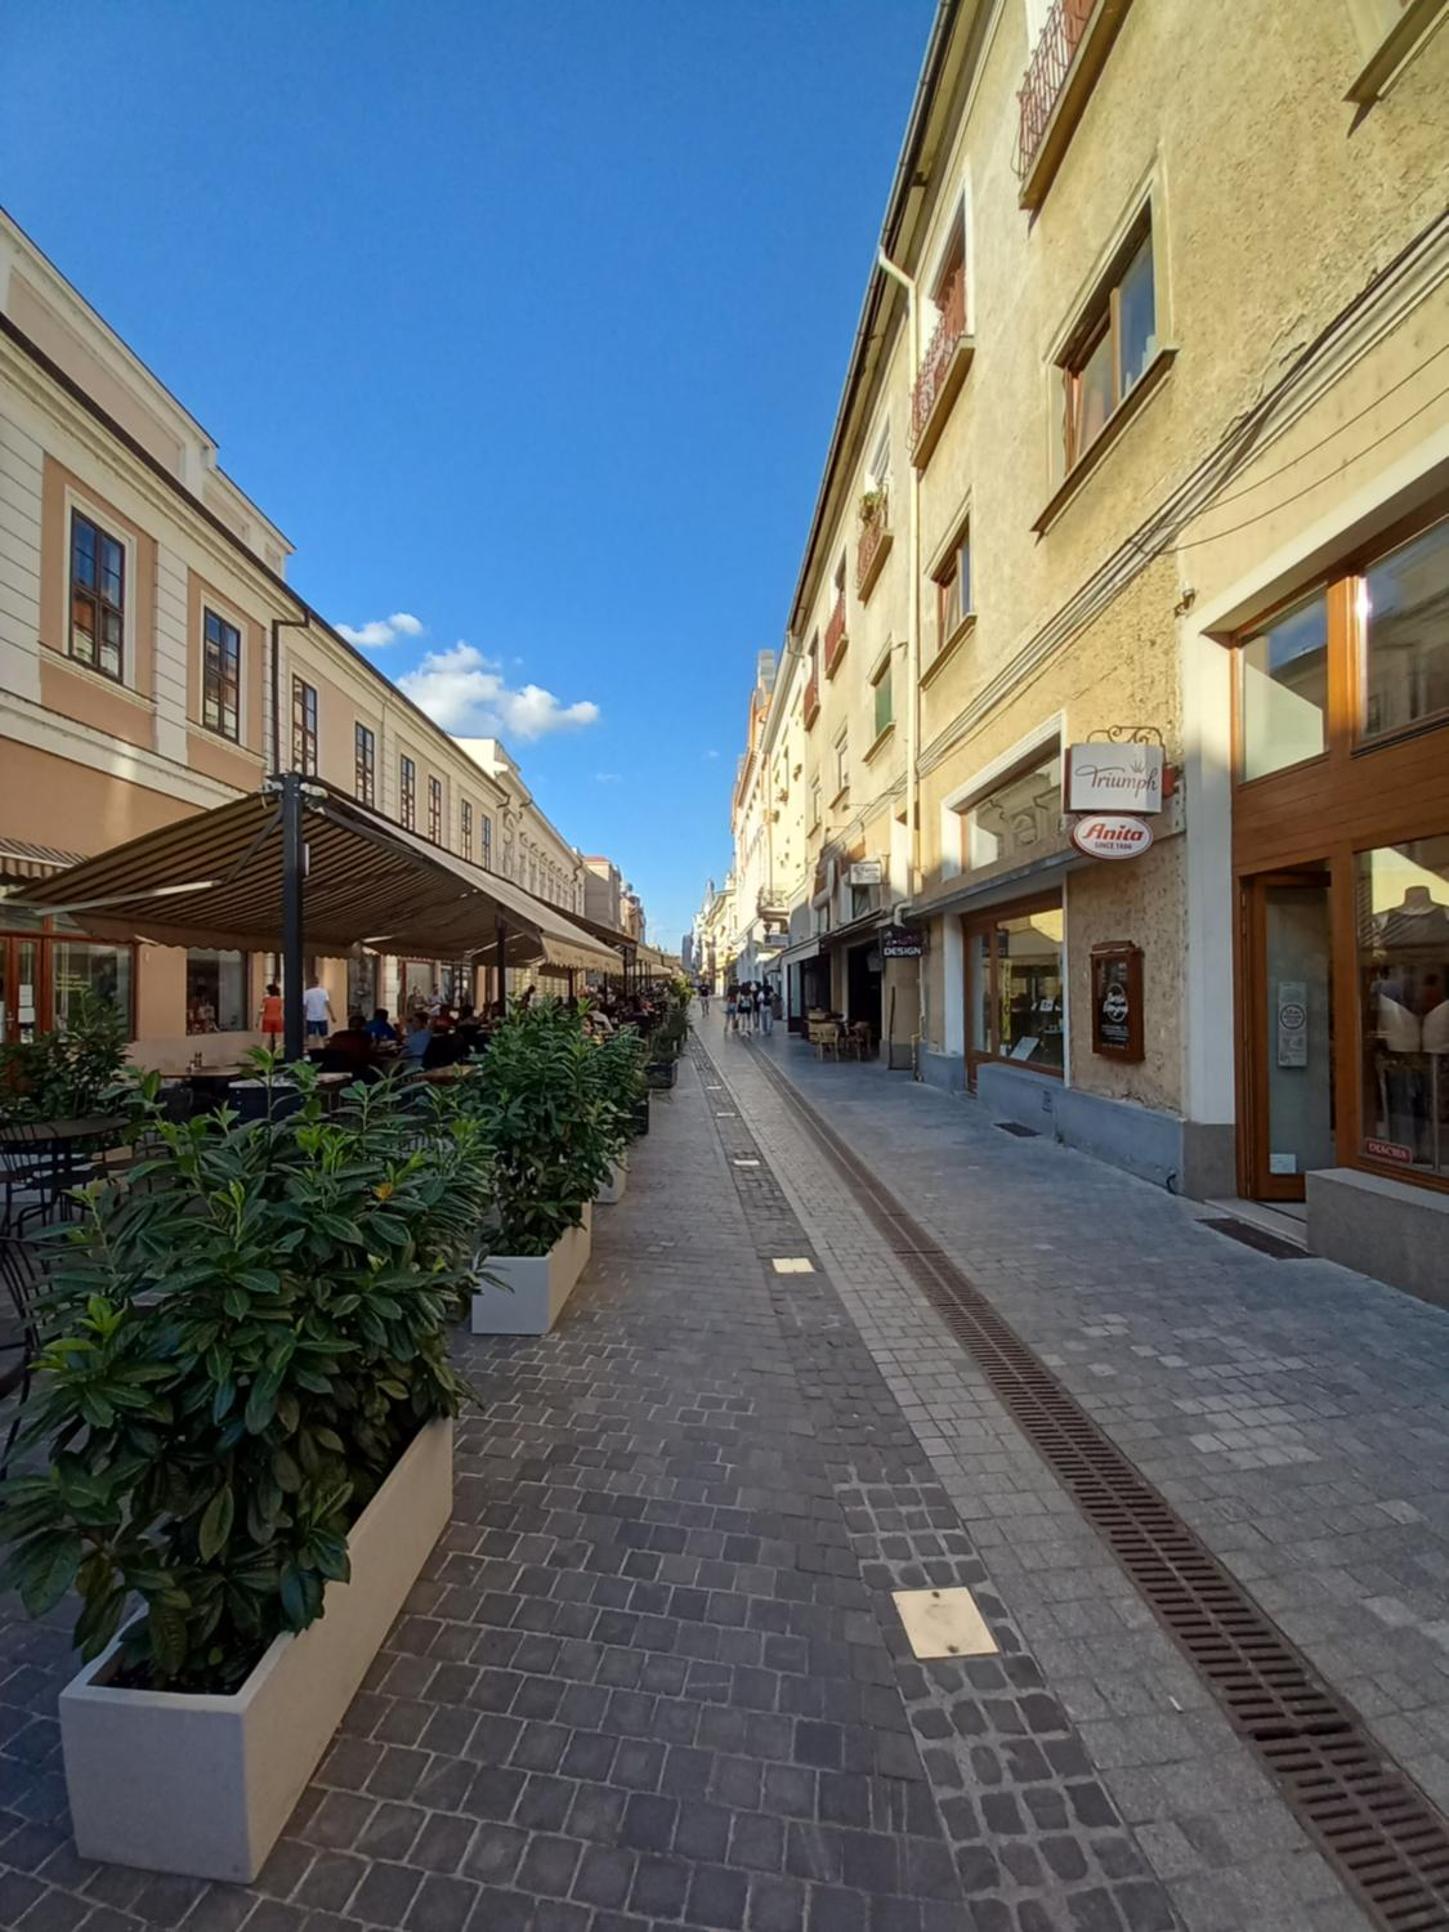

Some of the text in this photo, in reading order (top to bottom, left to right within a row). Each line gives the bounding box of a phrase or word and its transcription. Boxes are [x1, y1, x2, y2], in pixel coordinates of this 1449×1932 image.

[1074, 765, 1158, 798] Triumph
[1083, 823, 1144, 842] Anita
[1094, 842, 1114, 850] SINCE
[884, 947, 921, 956] DESIGN
